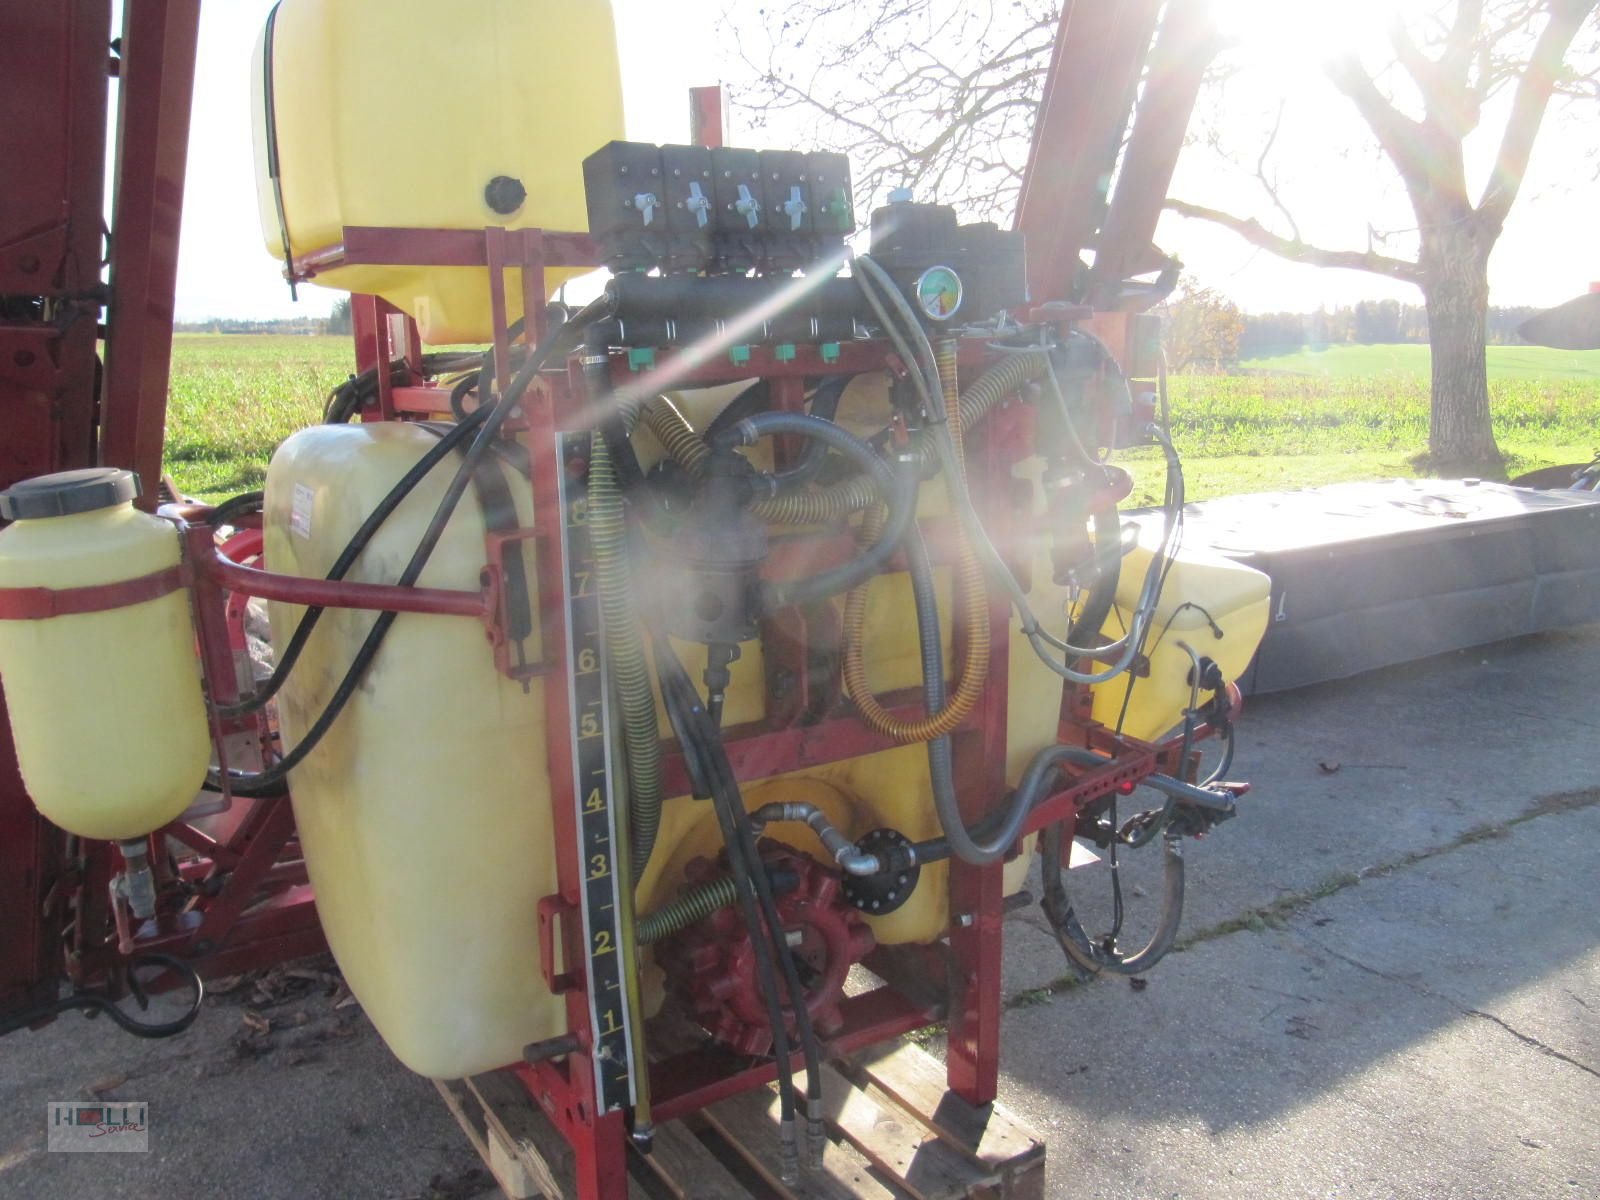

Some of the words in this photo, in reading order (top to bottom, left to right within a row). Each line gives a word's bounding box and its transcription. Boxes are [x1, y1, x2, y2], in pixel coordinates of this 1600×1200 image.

[575, 572, 589, 595] 7
[578, 649, 596, 671] 6
[581, 713, 597, 735] 5
[586, 788, 602, 810] 4
[591, 854, 607, 878] 3
[594, 931, 610, 954] 2
[603, 1010, 616, 1031] 1
